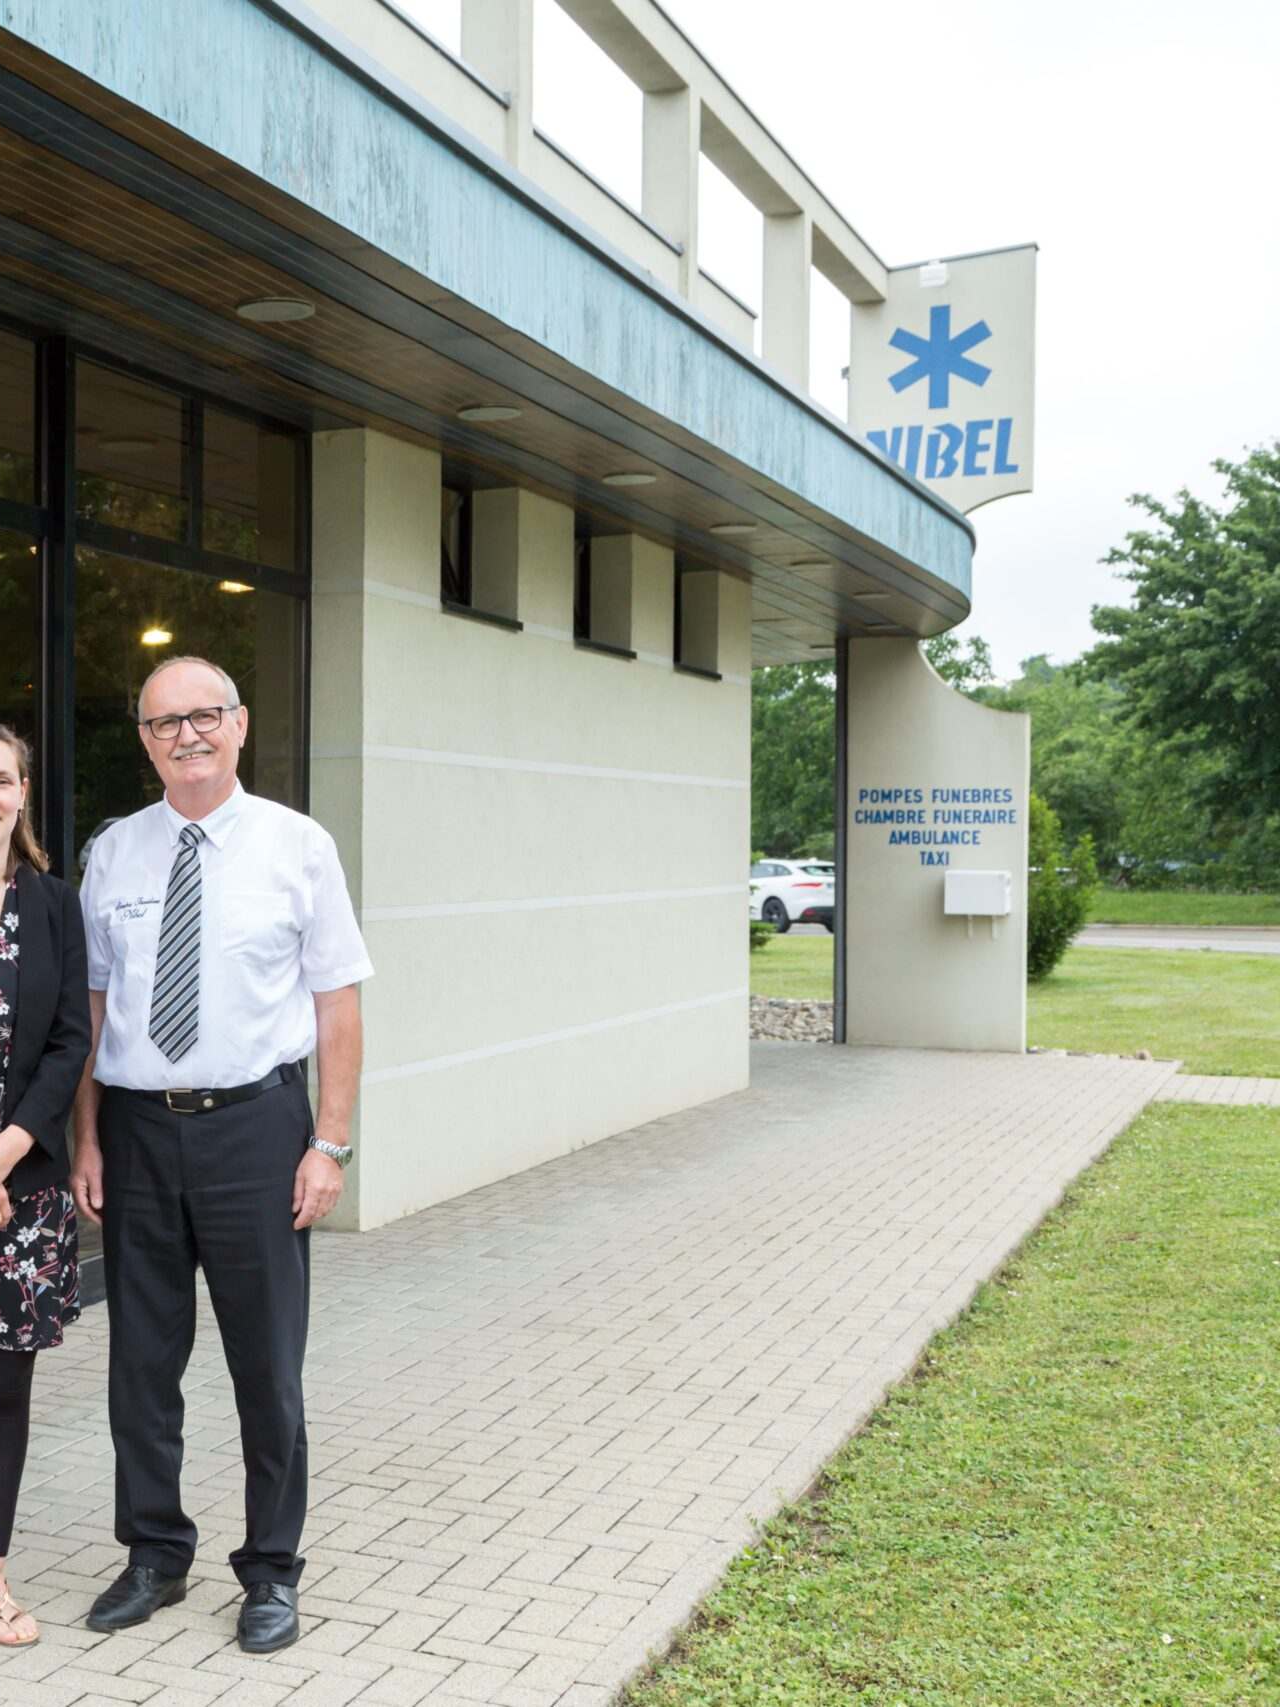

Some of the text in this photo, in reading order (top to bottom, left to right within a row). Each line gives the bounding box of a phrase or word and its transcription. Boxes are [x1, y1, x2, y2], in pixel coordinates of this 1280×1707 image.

[859, 787, 1013, 804] POMPES FUNEBRES
[855, 809, 1017, 825] CHAMBRE FUNERAIRE
[888, 830, 981, 846] AMBULANCE
[920, 851, 950, 866] TAXI
